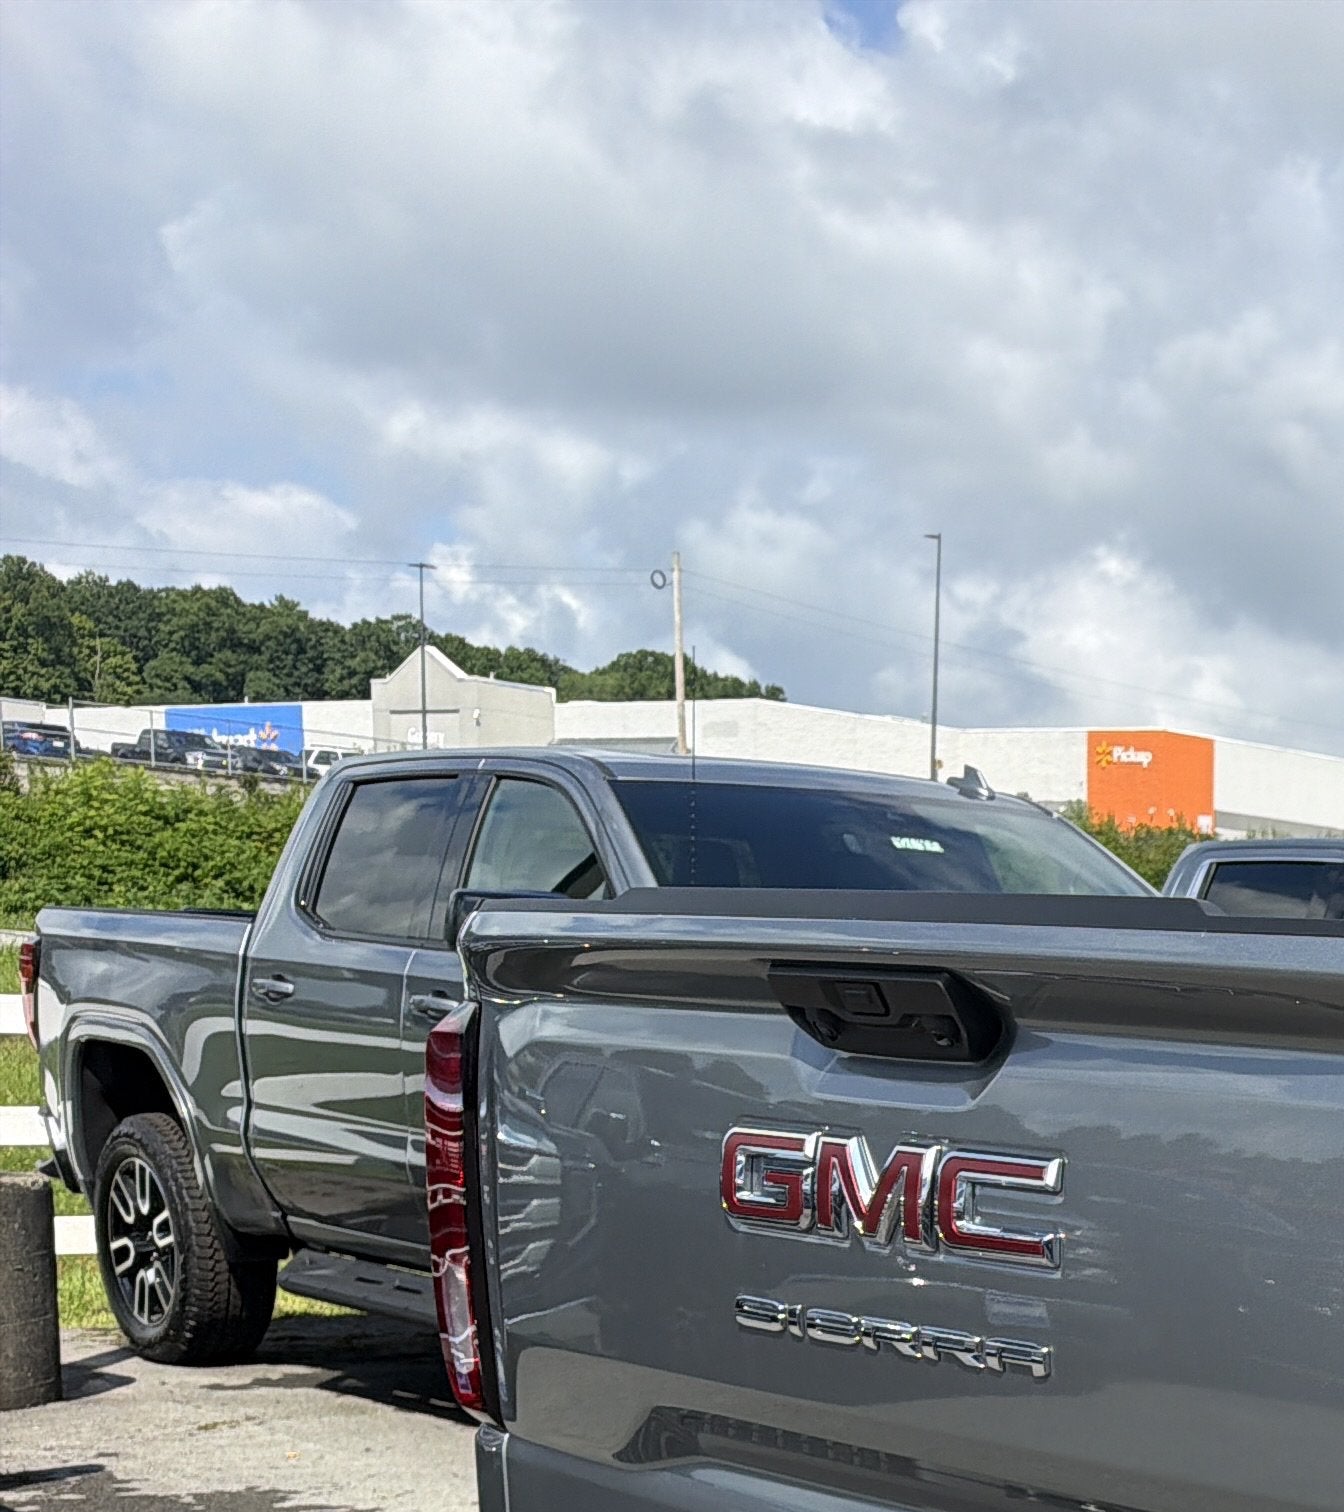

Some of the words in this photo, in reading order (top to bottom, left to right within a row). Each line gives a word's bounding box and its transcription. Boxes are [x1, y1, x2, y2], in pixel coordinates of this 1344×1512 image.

[1111, 745, 1153, 769] Pickup
[719, 1124, 1067, 1272] GMC
[734, 1293, 1054, 1379] SIERRA
